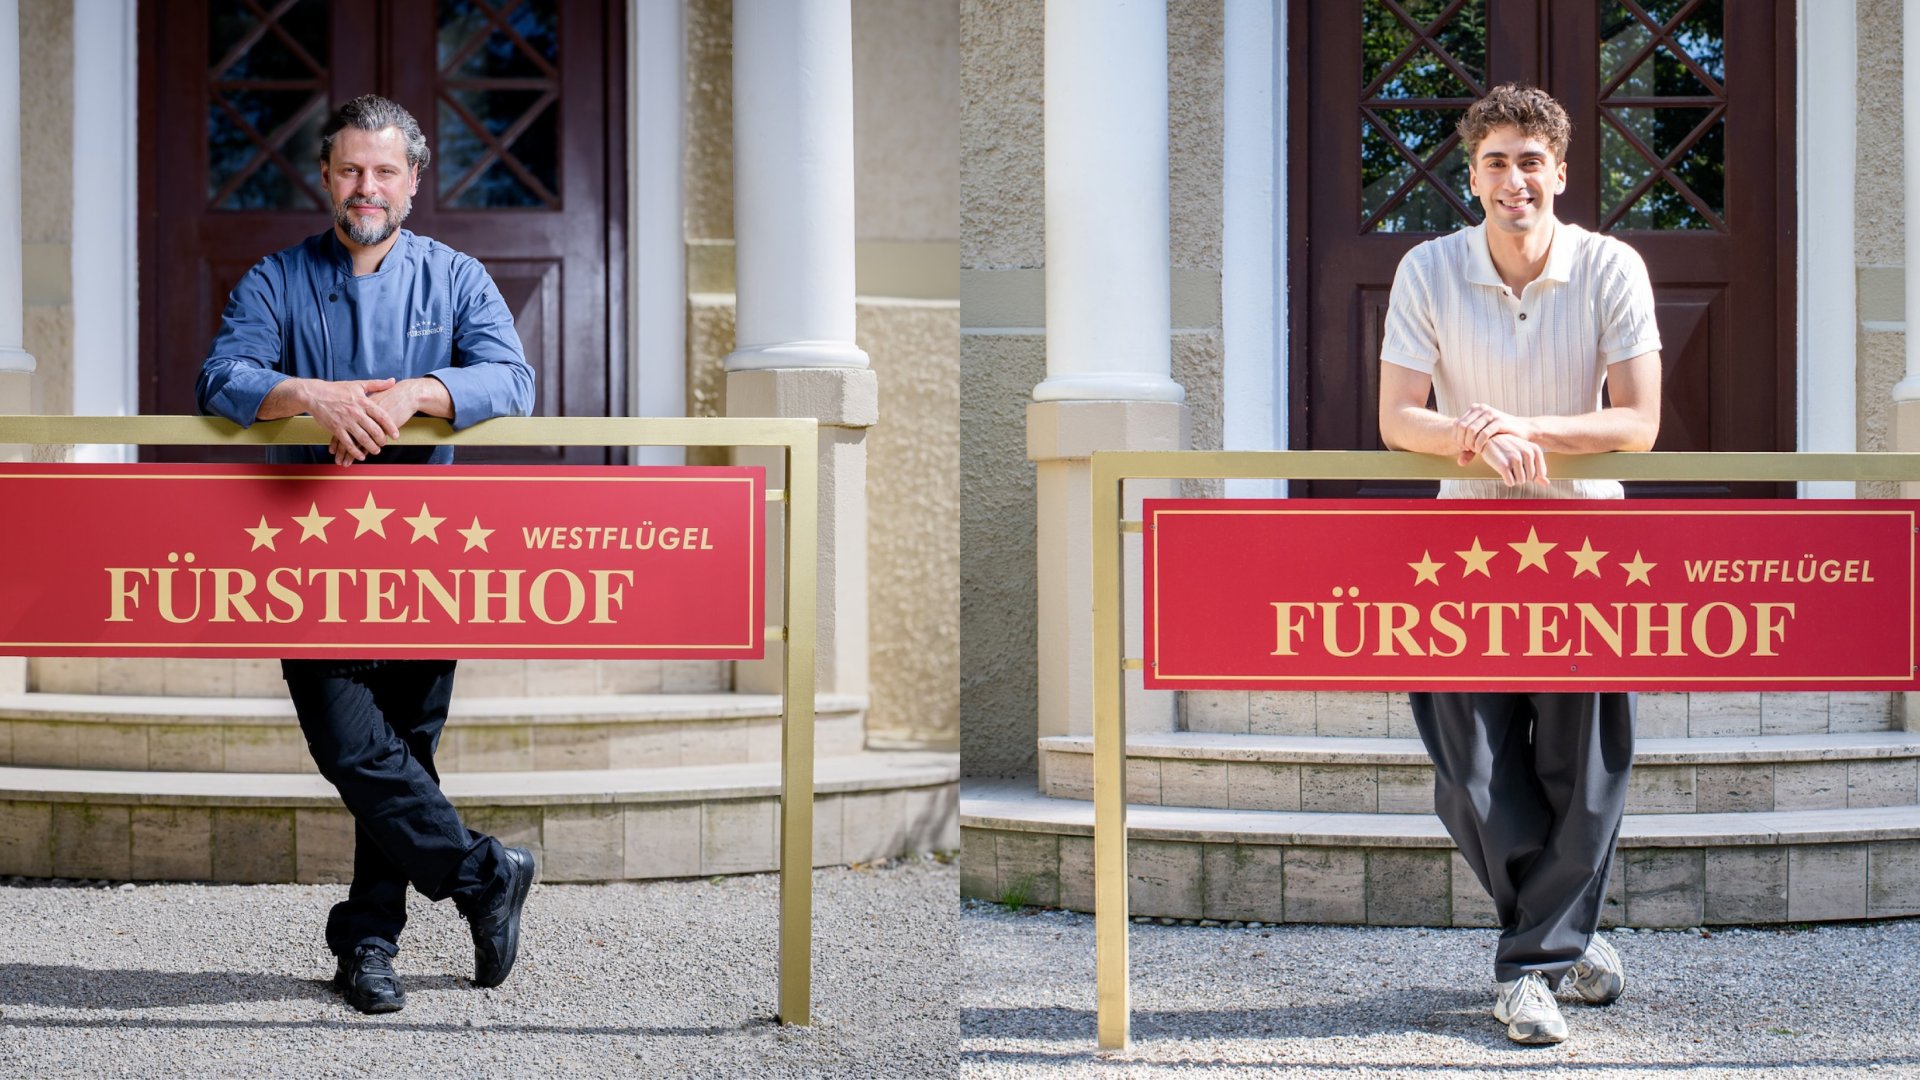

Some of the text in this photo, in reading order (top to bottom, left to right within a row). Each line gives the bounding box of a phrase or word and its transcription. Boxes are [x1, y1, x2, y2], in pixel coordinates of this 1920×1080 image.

[522, 521, 714, 550] WESTFLÜGEL
[105, 552, 635, 625] FÜRSTENHOF
[1684, 553, 1875, 583] WESTFLÜGEL
[1270, 586, 1796, 658] FÜRSTENHOF
